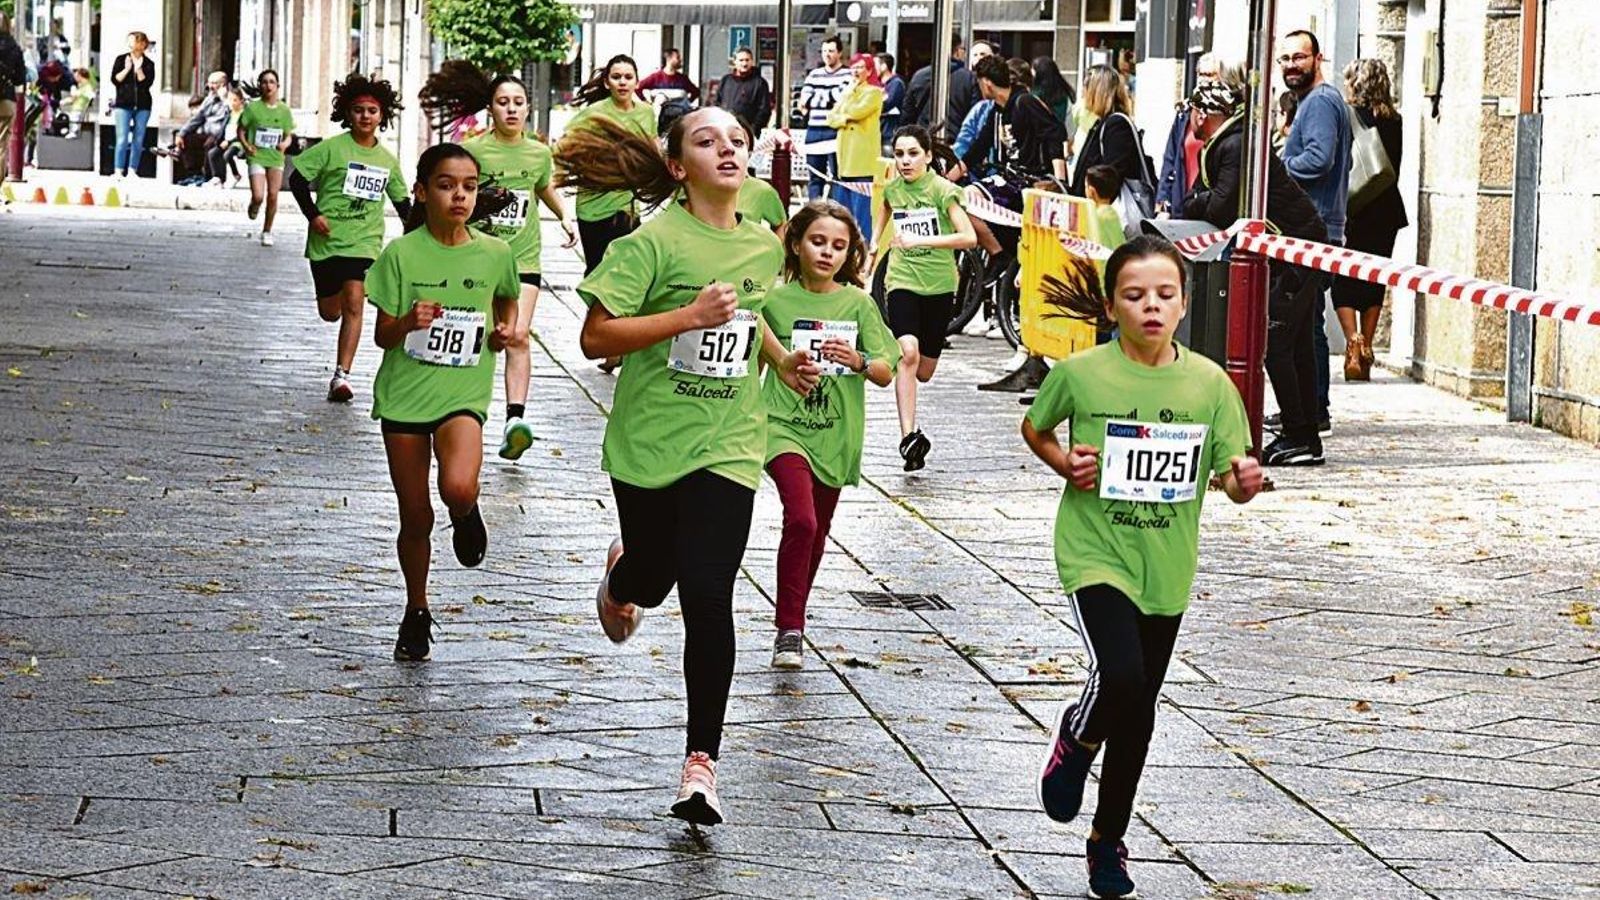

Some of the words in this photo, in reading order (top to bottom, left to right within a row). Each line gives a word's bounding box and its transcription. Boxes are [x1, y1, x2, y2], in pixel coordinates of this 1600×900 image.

[736, 30, 745, 46] P
[354, 175, 382, 193] 1056
[499, 202, 519, 218] 39
[428, 326, 465, 354] 518
[699, 331, 738, 362] 512
[674, 381, 738, 399] Salceda
[1109, 426, 1137, 436] Corre
[1153, 430, 1188, 440] Salceda
[1126, 449, 1187, 483] 1025
[1112, 511, 1170, 529] Salceda
